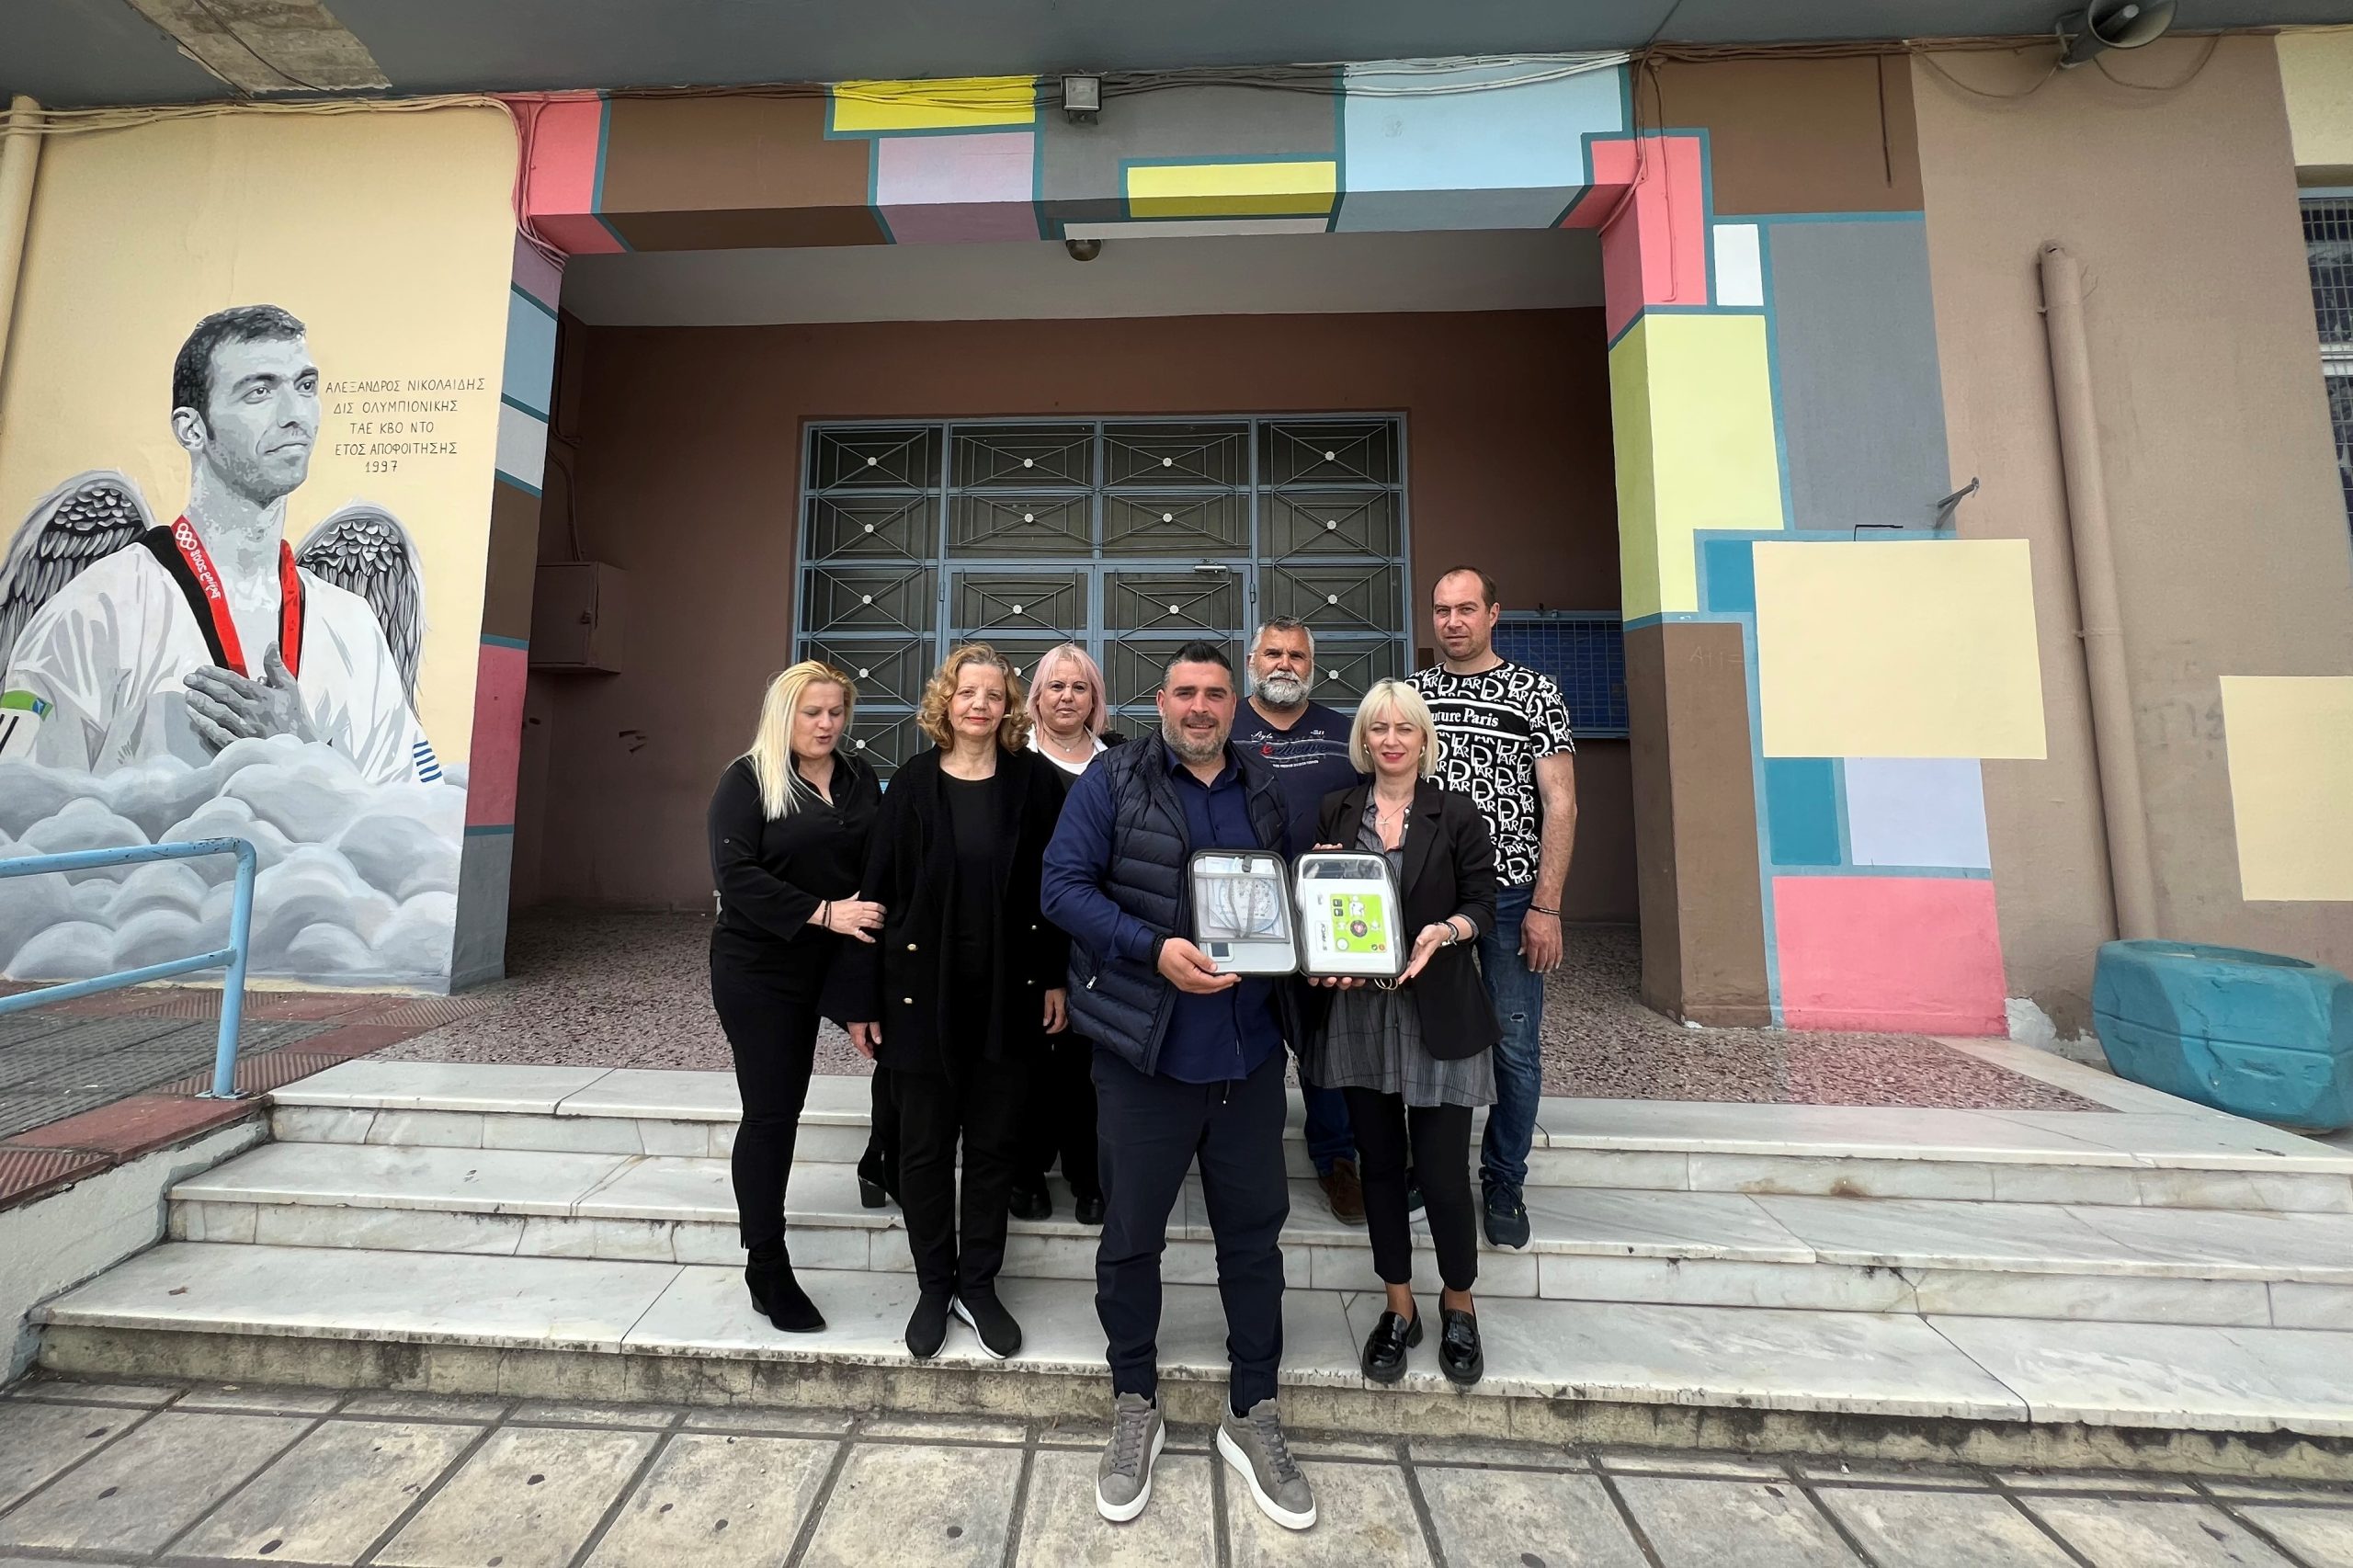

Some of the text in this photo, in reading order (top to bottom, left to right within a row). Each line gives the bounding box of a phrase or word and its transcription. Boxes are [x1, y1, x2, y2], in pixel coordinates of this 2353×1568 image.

[325, 378, 485, 393] ΑΛΕΞΑΝΔΡΟΣ ΝΙΚΟΛΑΙΔΗΣ
[333, 400, 458, 414] ΔΙΣ ΟΛΥΜΠΙΟΝΙΚΗΣ
[350, 422, 373, 434] ΤΑΕ
[410, 421, 434, 433] ΝΤΟ
[335, 442, 458, 456] ΕΤΟΣ ΑΠΟΦΟΙΤΗΣΗΣ
[365, 460, 398, 472] 1997
[1431, 708, 1499, 727] uture Paris
